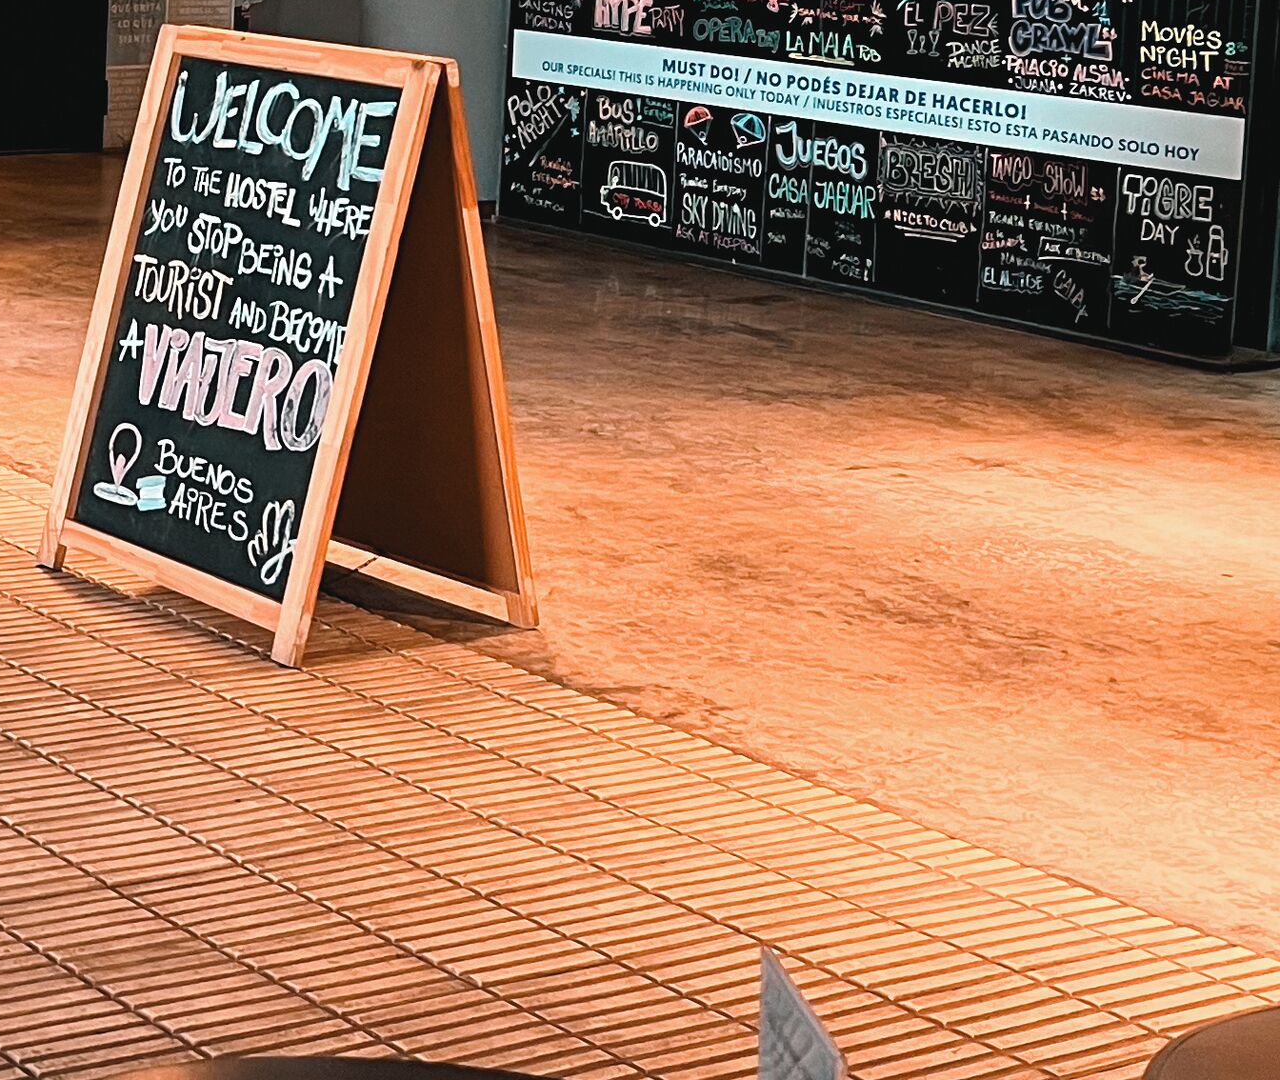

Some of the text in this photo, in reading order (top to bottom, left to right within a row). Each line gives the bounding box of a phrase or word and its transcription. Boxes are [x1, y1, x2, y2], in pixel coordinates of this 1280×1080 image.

[946, 39, 1002, 57] DANCE
[542, 60, 564, 74] OUR
[567, 63, 616, 81] SPECIALS!
[619, 70, 642, 84] THIS
[644, 73, 654, 85] IS
[657, 75, 722, 95] HAPPENING
[725, 83, 756, 100] ONLY
[759, 87, 799, 106] TODAY
[967, 118, 1001, 134] ESTO
[1005, 123, 1038, 140] ESTA
[1042, 127, 1114, 150] PASANDO
[1118, 138, 1160, 156] SOLO
[1164, 145, 1200, 162] HOY
[662, 59, 1027, 120] MUST DO! NO PODÉS DEJAR DE HACERLO!
[1141, 84, 1182, 100] CASA
[171, 70, 397, 191] WELCOME
[164, 157, 374, 236] TO THE HOSTEL WHERE
[768, 172, 809, 205] CASA
[145, 198, 343, 298] YOU STOP BEING A
[1140, 219, 1180, 245] DAY
[134, 254, 348, 366] TOURIST AND BECOME
[119, 319, 336, 451] A VIAJERO
[155, 439, 254, 505] BUENOS
[168, 491, 249, 541] AIRES
